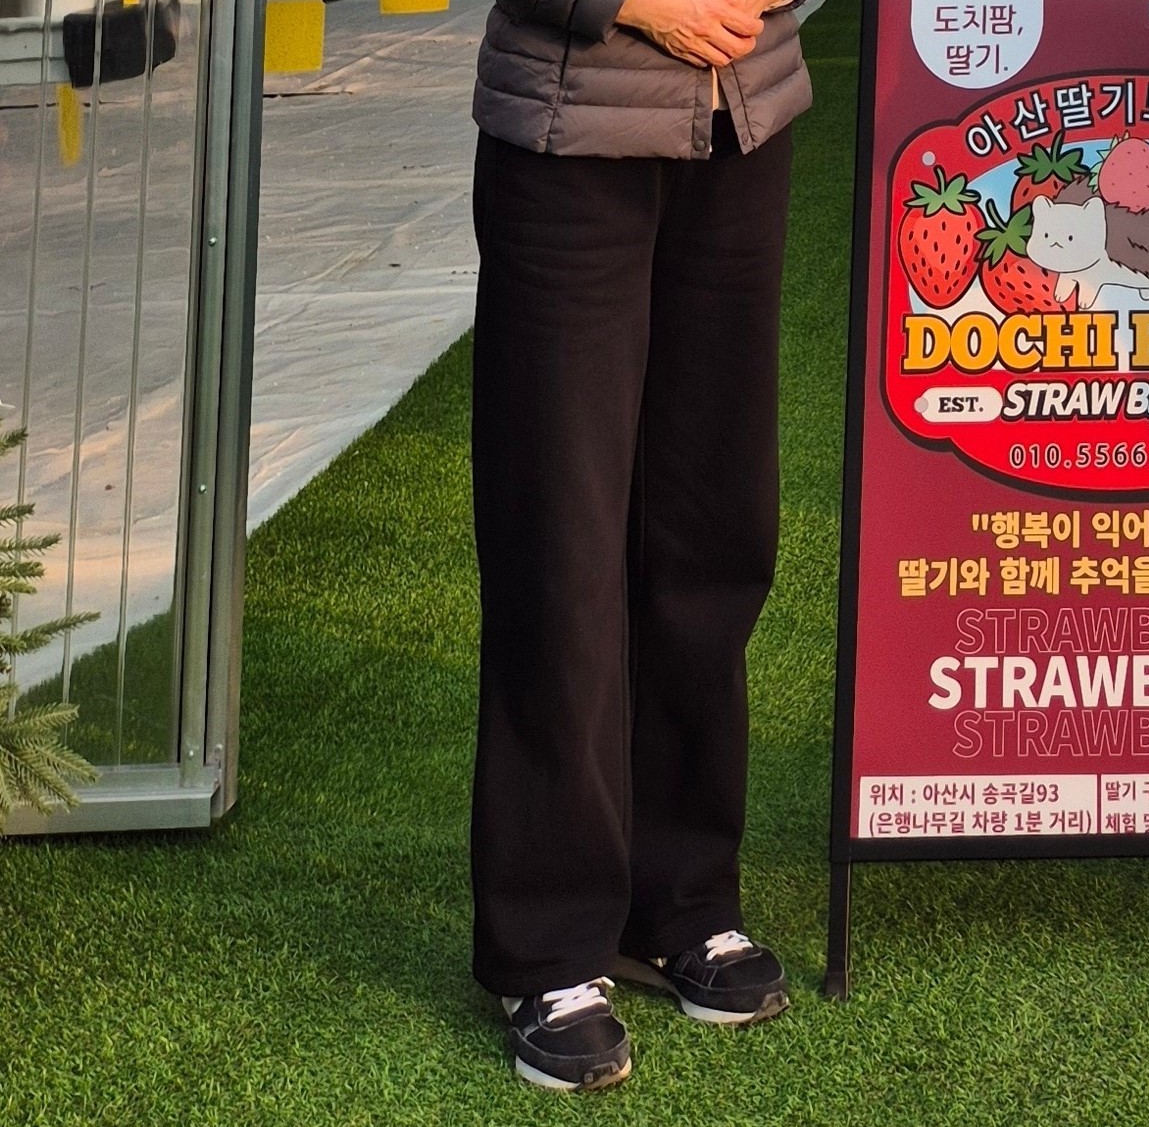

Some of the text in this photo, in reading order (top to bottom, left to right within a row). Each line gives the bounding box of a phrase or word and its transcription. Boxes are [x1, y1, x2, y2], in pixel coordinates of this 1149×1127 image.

[933, 4, 1023, 35] 도치팜,
[946, 44, 1008, 75] 딸기.
[902, 312, 1116, 370] DOCHI
[938, 396, 984, 413] EST.
[972, 511, 1080, 549] "행복이
[898, 557, 990, 596] 딸기와
[1000, 556, 1059, 595] 함께
[870, 783, 904, 806] 위치
[923, 782, 975, 806] 아산시
[982, 782, 1059, 805] 송곡길93
[1105, 780, 1136, 801] 딸기
[869, 809, 1091, 836] (은행나무길 차량 1분 거리)
[1105, 812, 1136, 833] 체험
